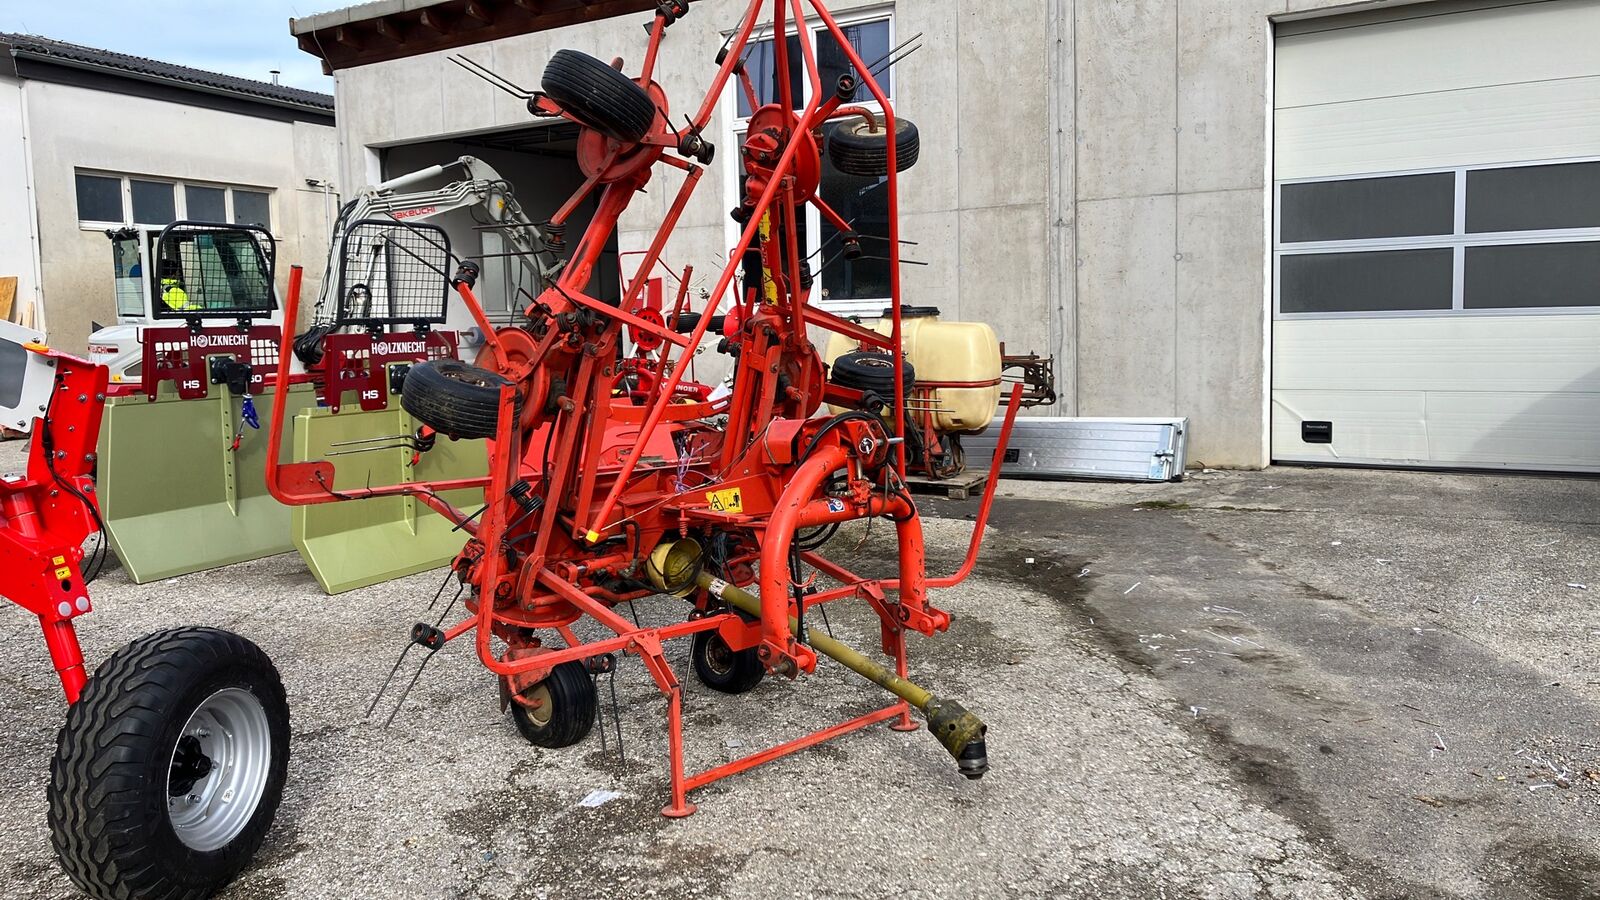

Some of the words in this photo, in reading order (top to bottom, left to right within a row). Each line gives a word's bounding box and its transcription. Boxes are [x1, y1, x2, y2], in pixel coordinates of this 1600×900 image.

[190, 334, 249, 348] HOLZKNECHT
[371, 341, 426, 355] HOLZKNECHT
[183, 380, 200, 389] HS
[362, 390, 379, 400] HS
